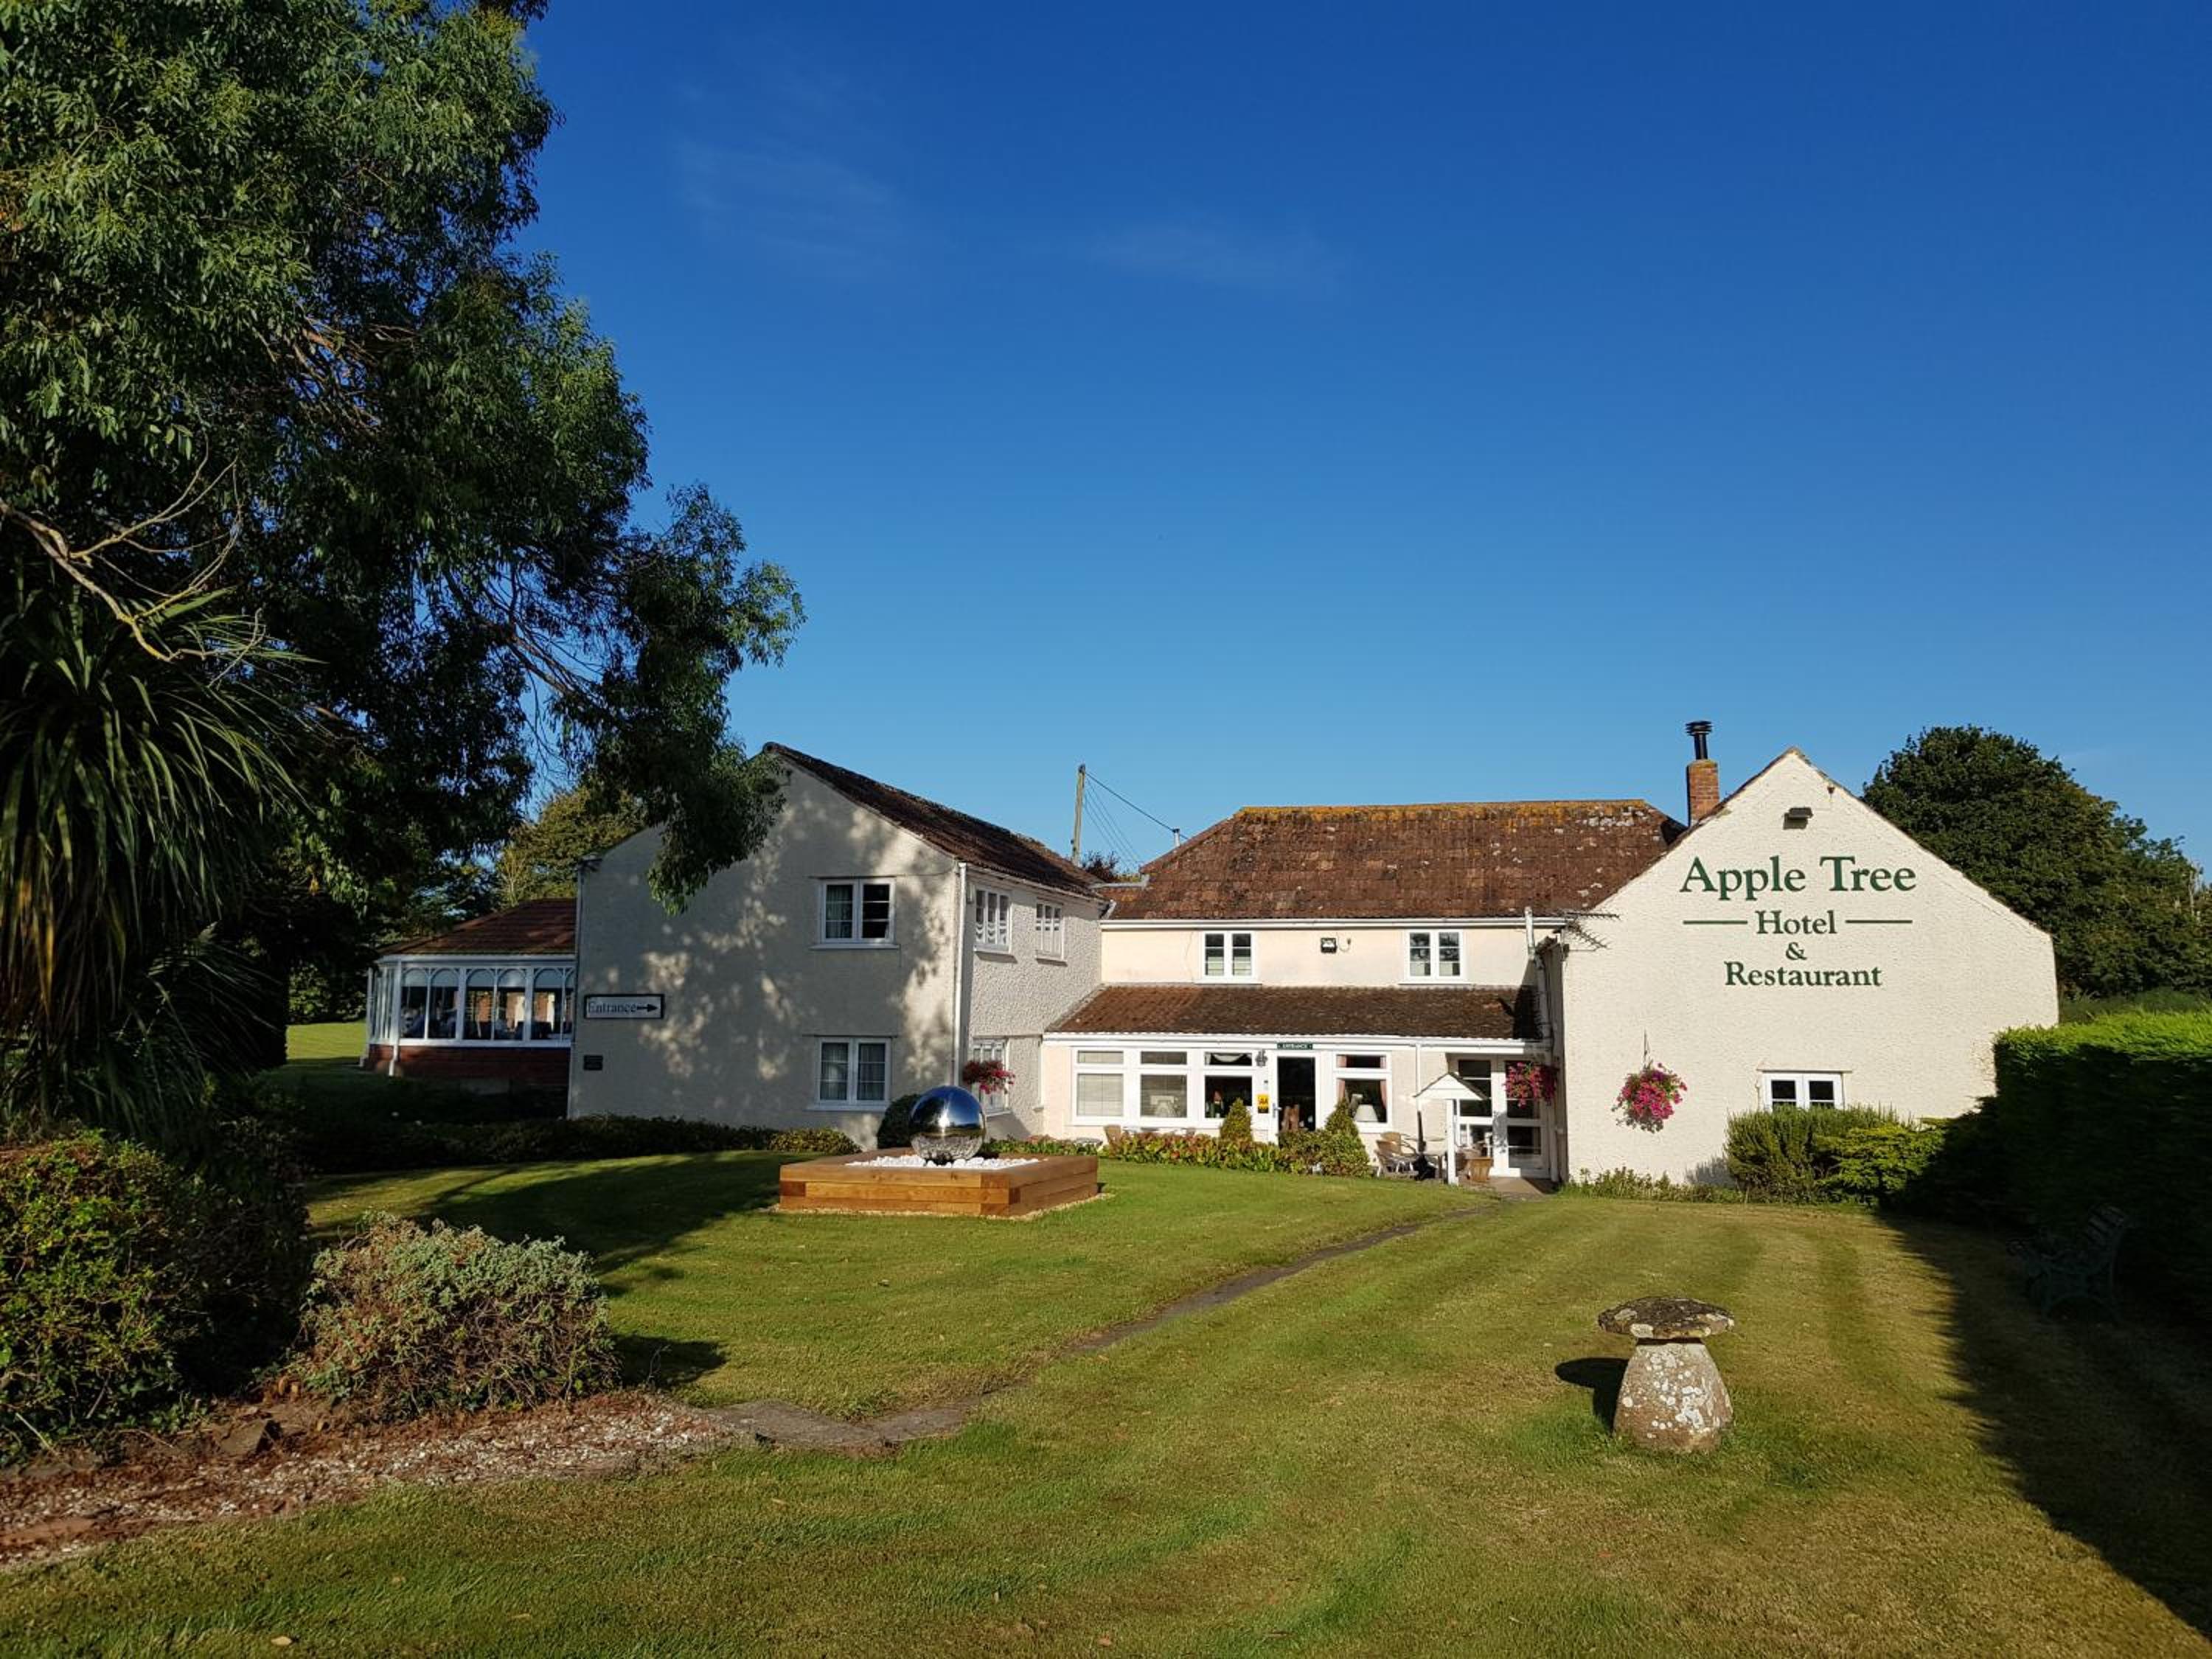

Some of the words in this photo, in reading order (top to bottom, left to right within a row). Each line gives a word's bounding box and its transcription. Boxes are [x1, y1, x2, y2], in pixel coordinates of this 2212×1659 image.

[1680, 855, 1806, 901] Apple
[1819, 856, 1916, 891] Tree
[1755, 910, 1837, 934] Hotel
[1786, 942, 1807, 960] &
[1724, 961, 1882, 987] Restaurant
[588, 1001, 636, 1013] Entrance
